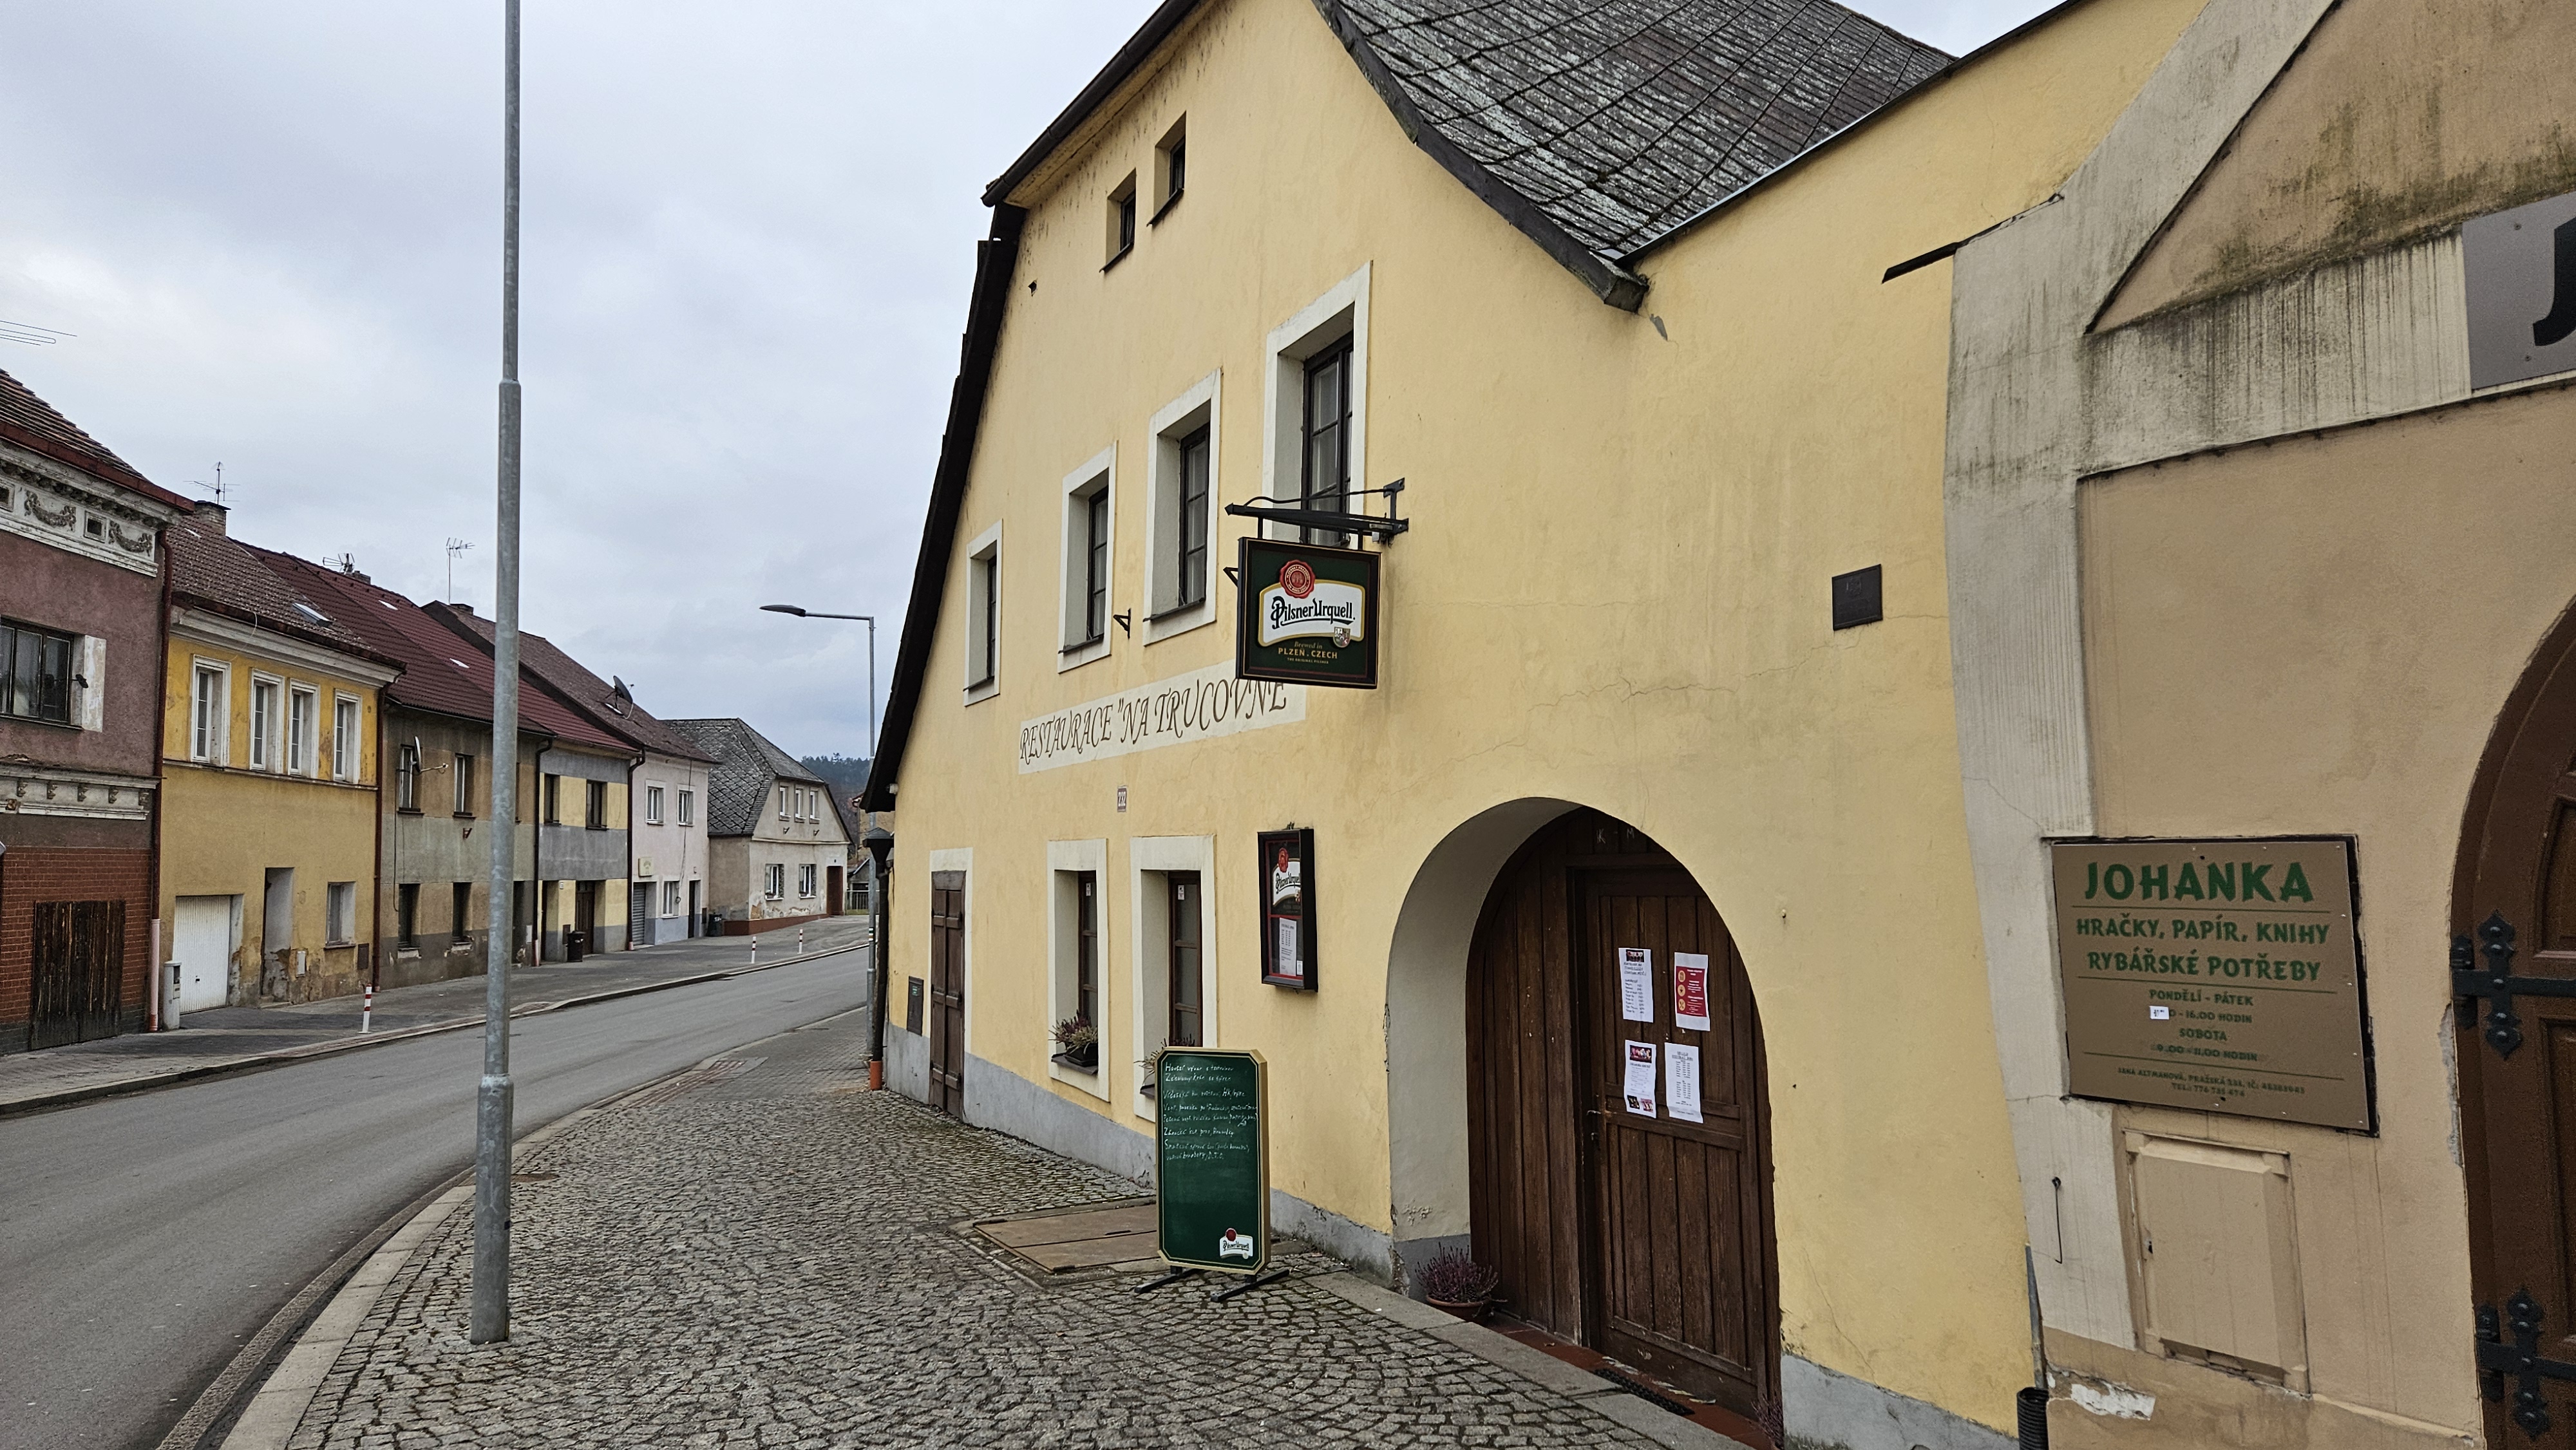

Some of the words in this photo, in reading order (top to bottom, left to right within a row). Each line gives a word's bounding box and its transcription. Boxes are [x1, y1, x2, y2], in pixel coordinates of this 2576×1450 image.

[1271, 596, 1313, 629] Pilsner
[1311, 650, 1338, 659] CZECH
[1020, 705, 1113, 765] RESTAURACE
[2085, 861, 2314, 903] JOHANKA
[2076, 912, 2165, 939] HRAČKY,
[2172, 914, 2248, 943] PAPÍR,
[2256, 921, 2330, 945] KNIHY
[2087, 946, 2200, 975] RYBÁŘSKÉ
[2207, 952, 2321, 981] POTŘEBY
[2148, 988, 2202, 1003] PONDĚLÍ
[2214, 991, 2254, 1006] PÁTEK
[2185, 1010, 2216, 1021] 16.00
[2217, 1013, 2253, 1024] HODIN
[2179, 1028, 2228, 1041] SOBOTA
[2222, 1050, 2258, 1062] HODIN
